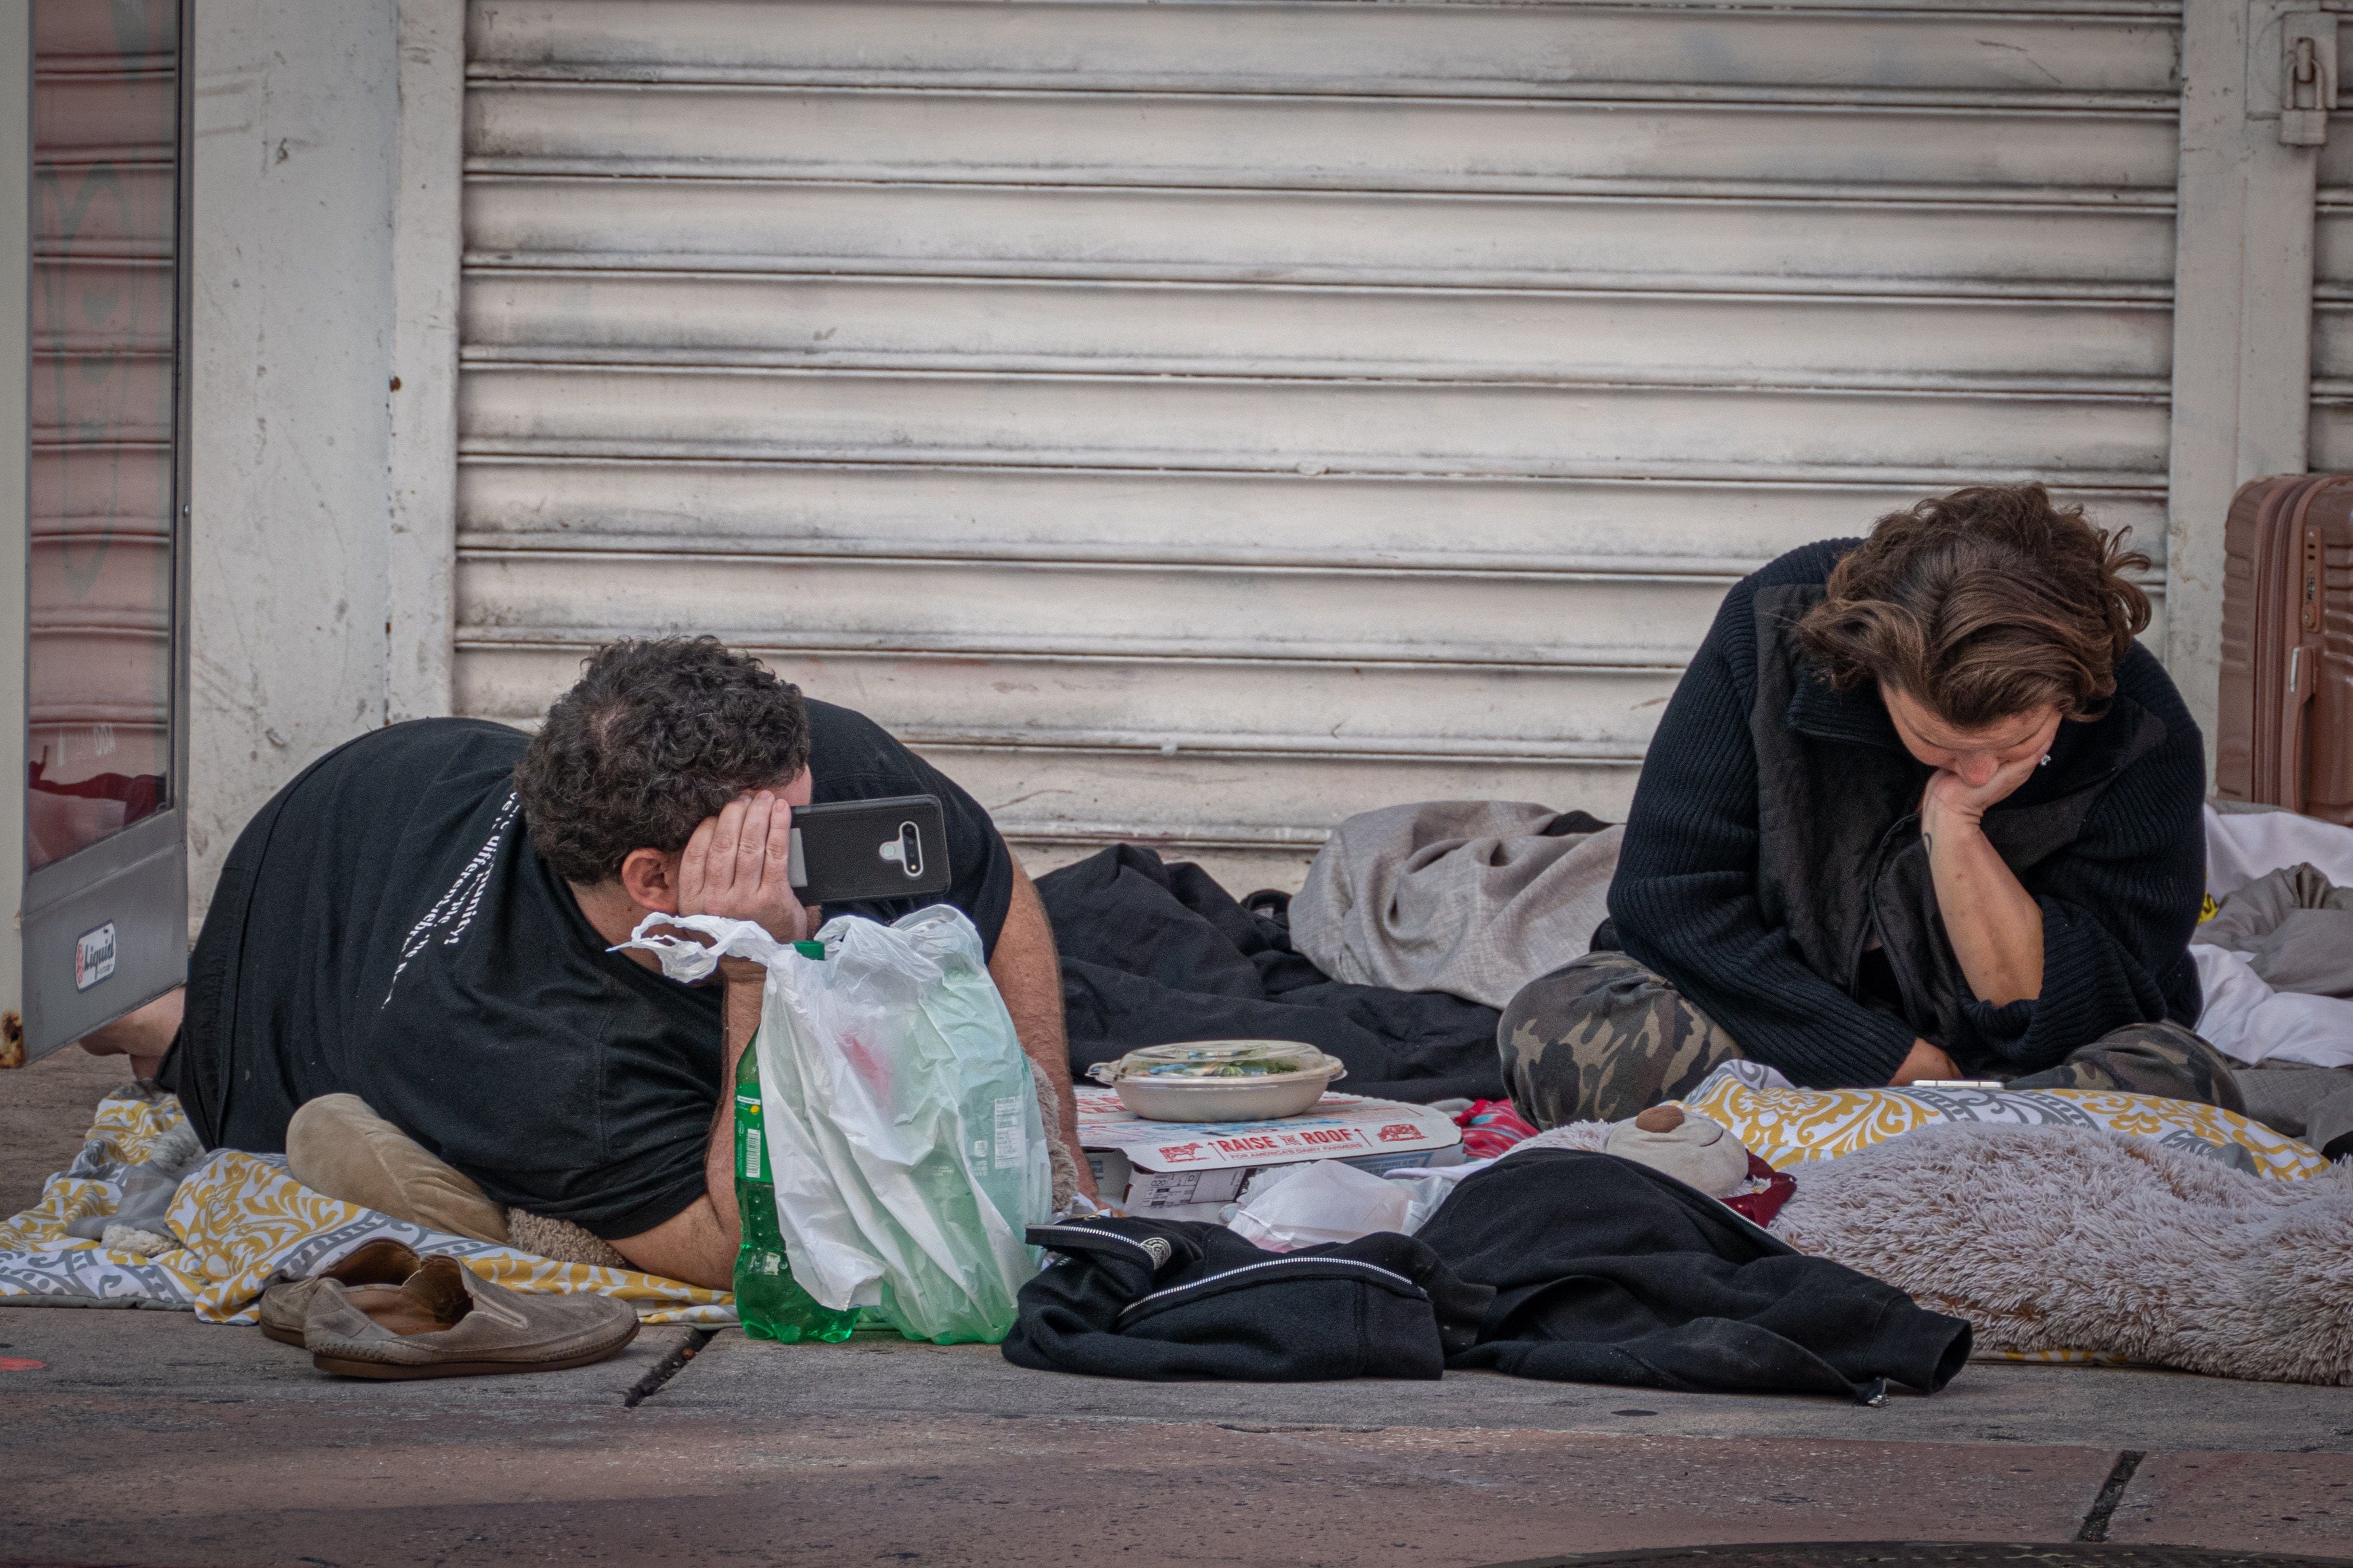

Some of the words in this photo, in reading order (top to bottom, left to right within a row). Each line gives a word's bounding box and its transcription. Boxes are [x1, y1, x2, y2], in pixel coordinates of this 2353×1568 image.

[1216, 1135, 1280, 1153] RAISE
[1299, 1128, 1353, 1145] ROOF
[1250, 1149, 1295, 1157] AMERICA'S
[1323, 1143, 1363, 1151] FARMERS
